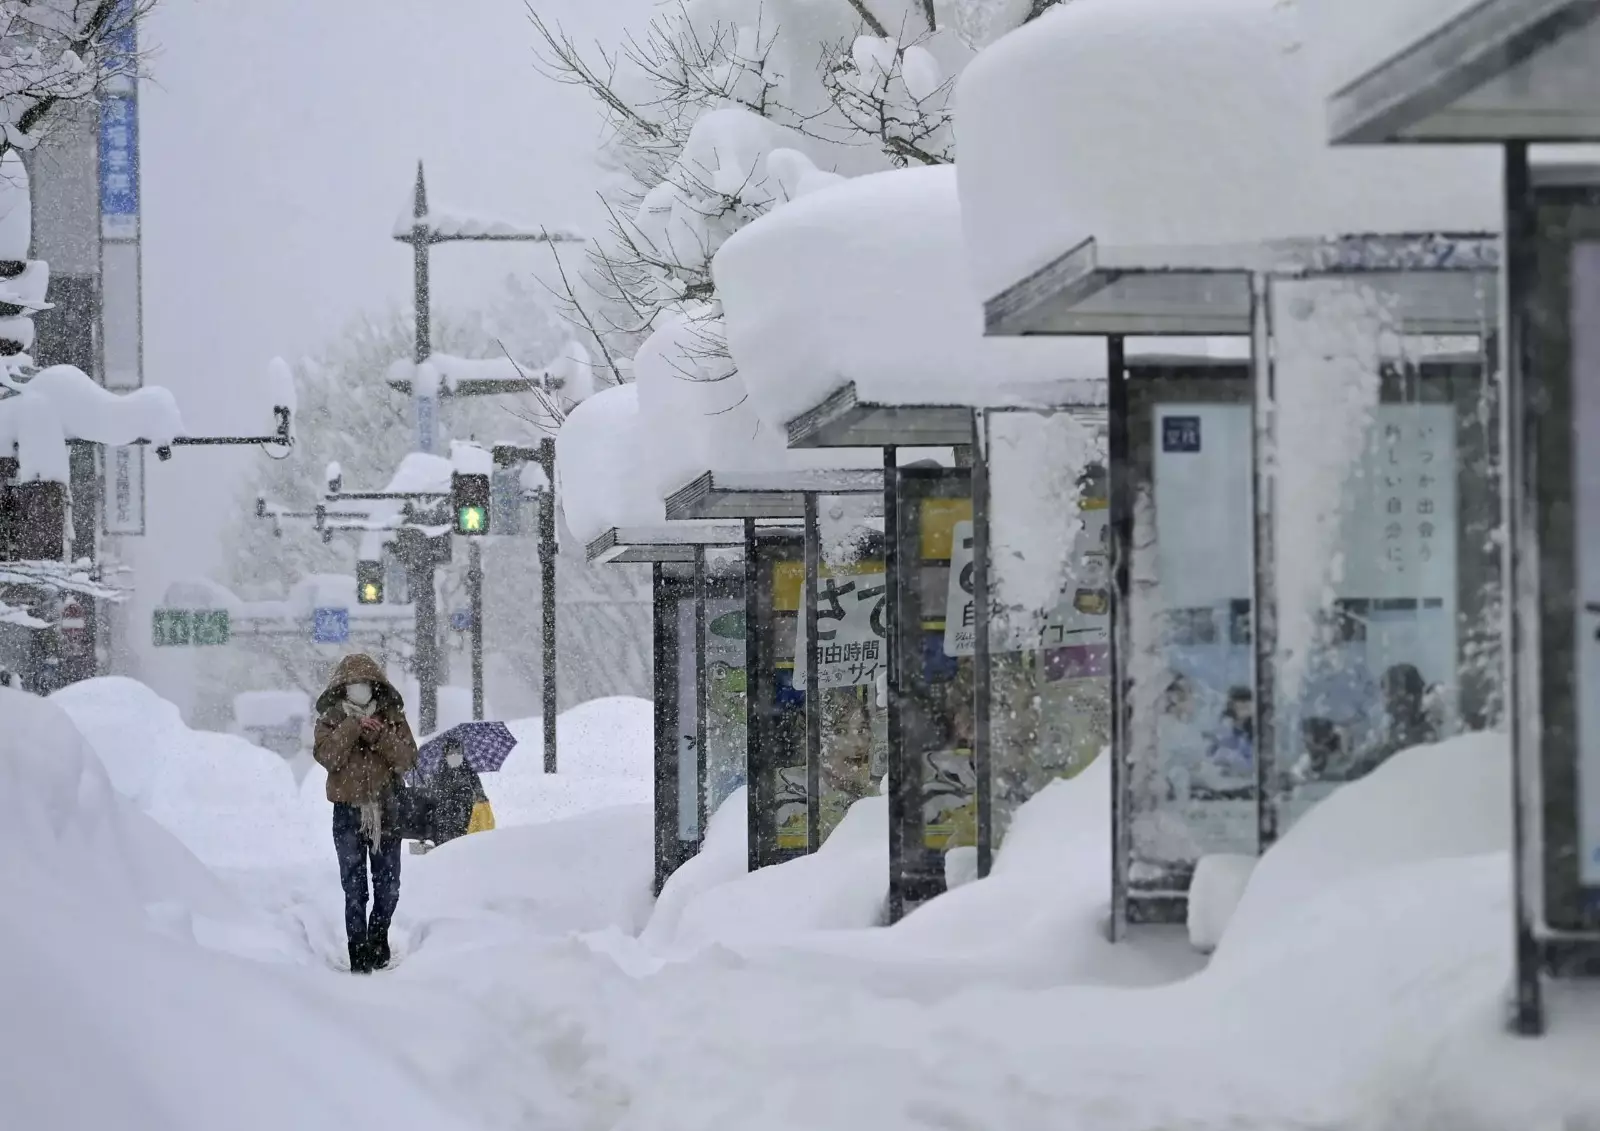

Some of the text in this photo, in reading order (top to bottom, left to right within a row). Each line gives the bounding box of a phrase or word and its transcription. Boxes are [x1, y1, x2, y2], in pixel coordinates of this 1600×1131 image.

[1417, 427, 1435, 562] いつか出会う
